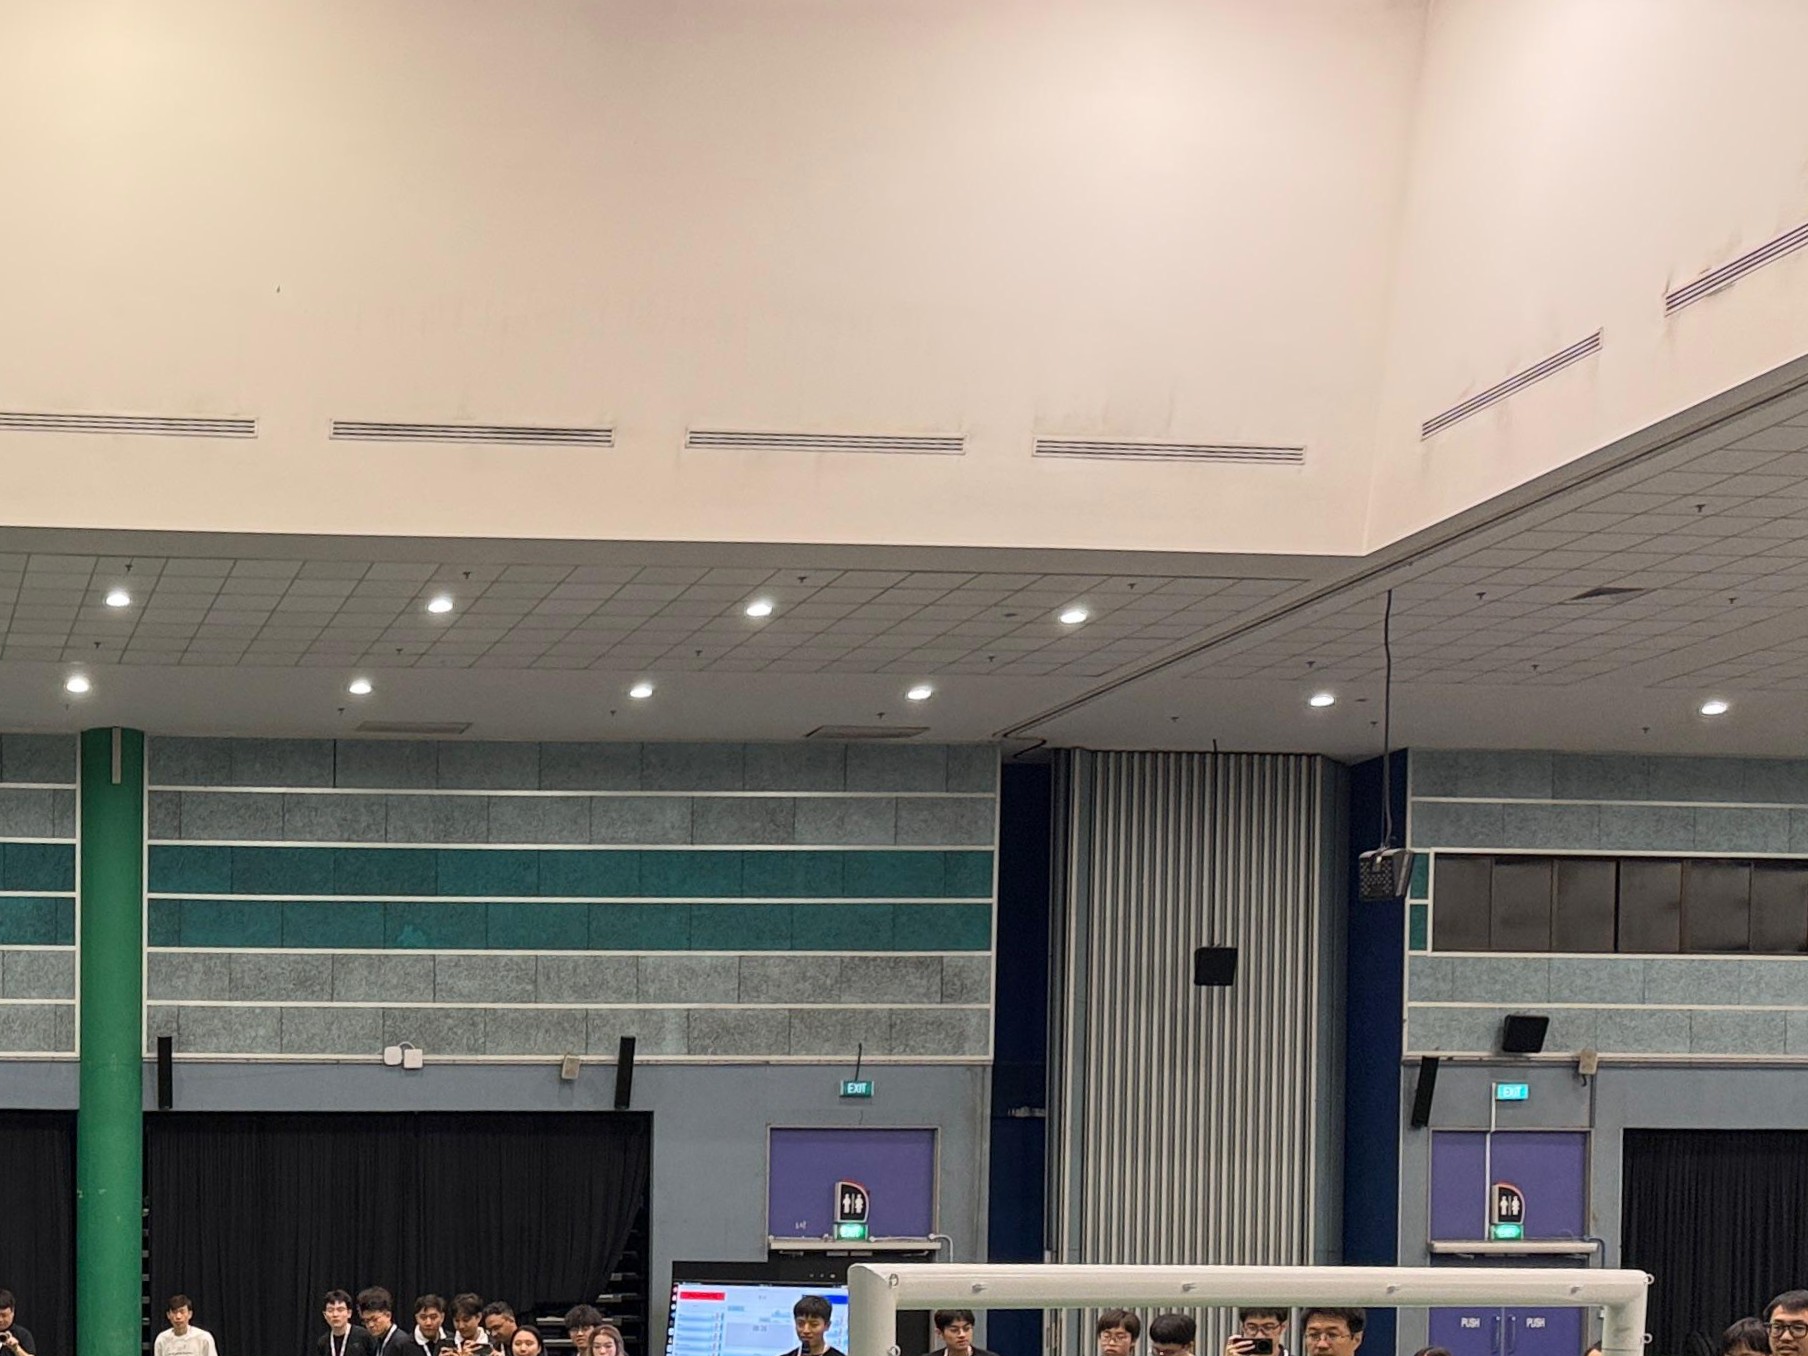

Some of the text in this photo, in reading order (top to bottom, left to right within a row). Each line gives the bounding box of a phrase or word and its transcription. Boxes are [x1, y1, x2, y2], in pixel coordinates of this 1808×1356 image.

[847, 1082, 867, 1094] EXIT
[1460, 1317, 1480, 1328] PUSH
[1526, 1317, 1545, 1328] PUSH
